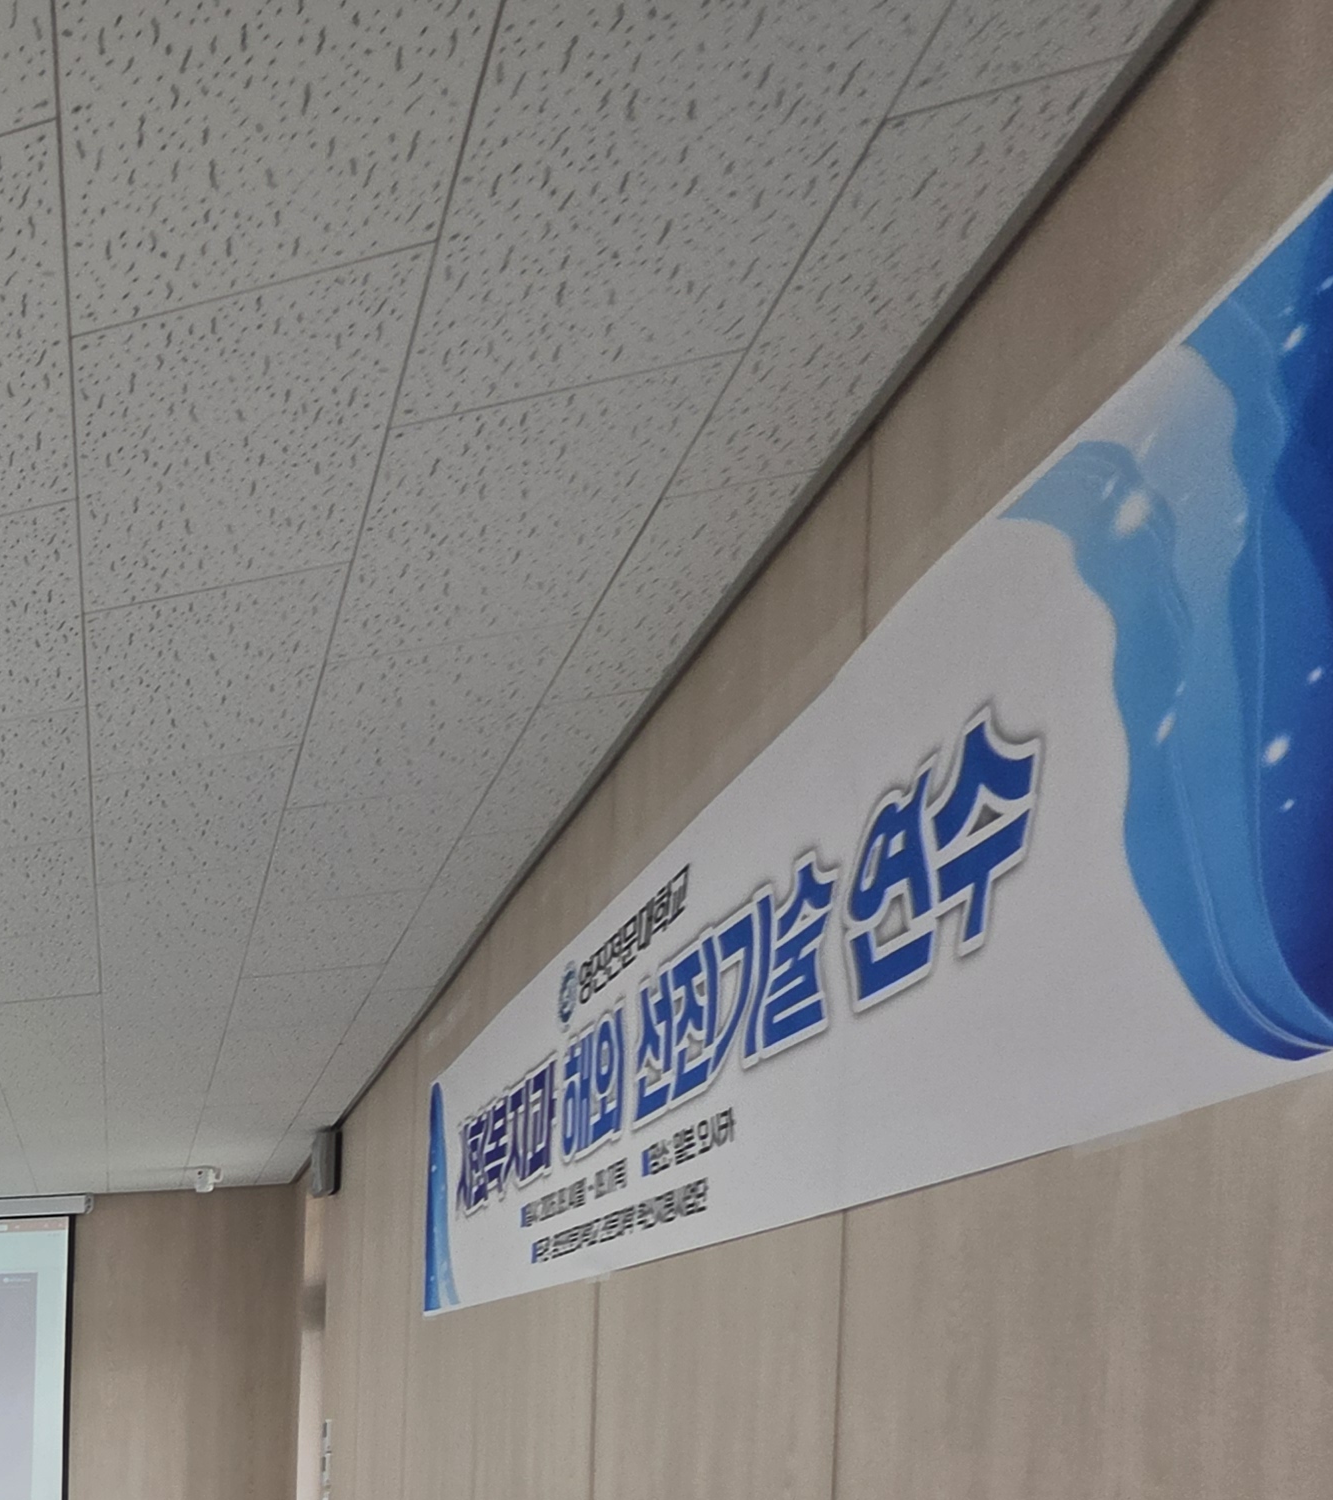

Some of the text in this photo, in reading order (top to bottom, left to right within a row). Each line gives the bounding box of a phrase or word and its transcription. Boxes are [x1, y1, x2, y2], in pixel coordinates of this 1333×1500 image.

[561, 1007, 624, 1158] 해외
[633, 858, 834, 1122] 선진기술
[847, 716, 1034, 1003] 연수
